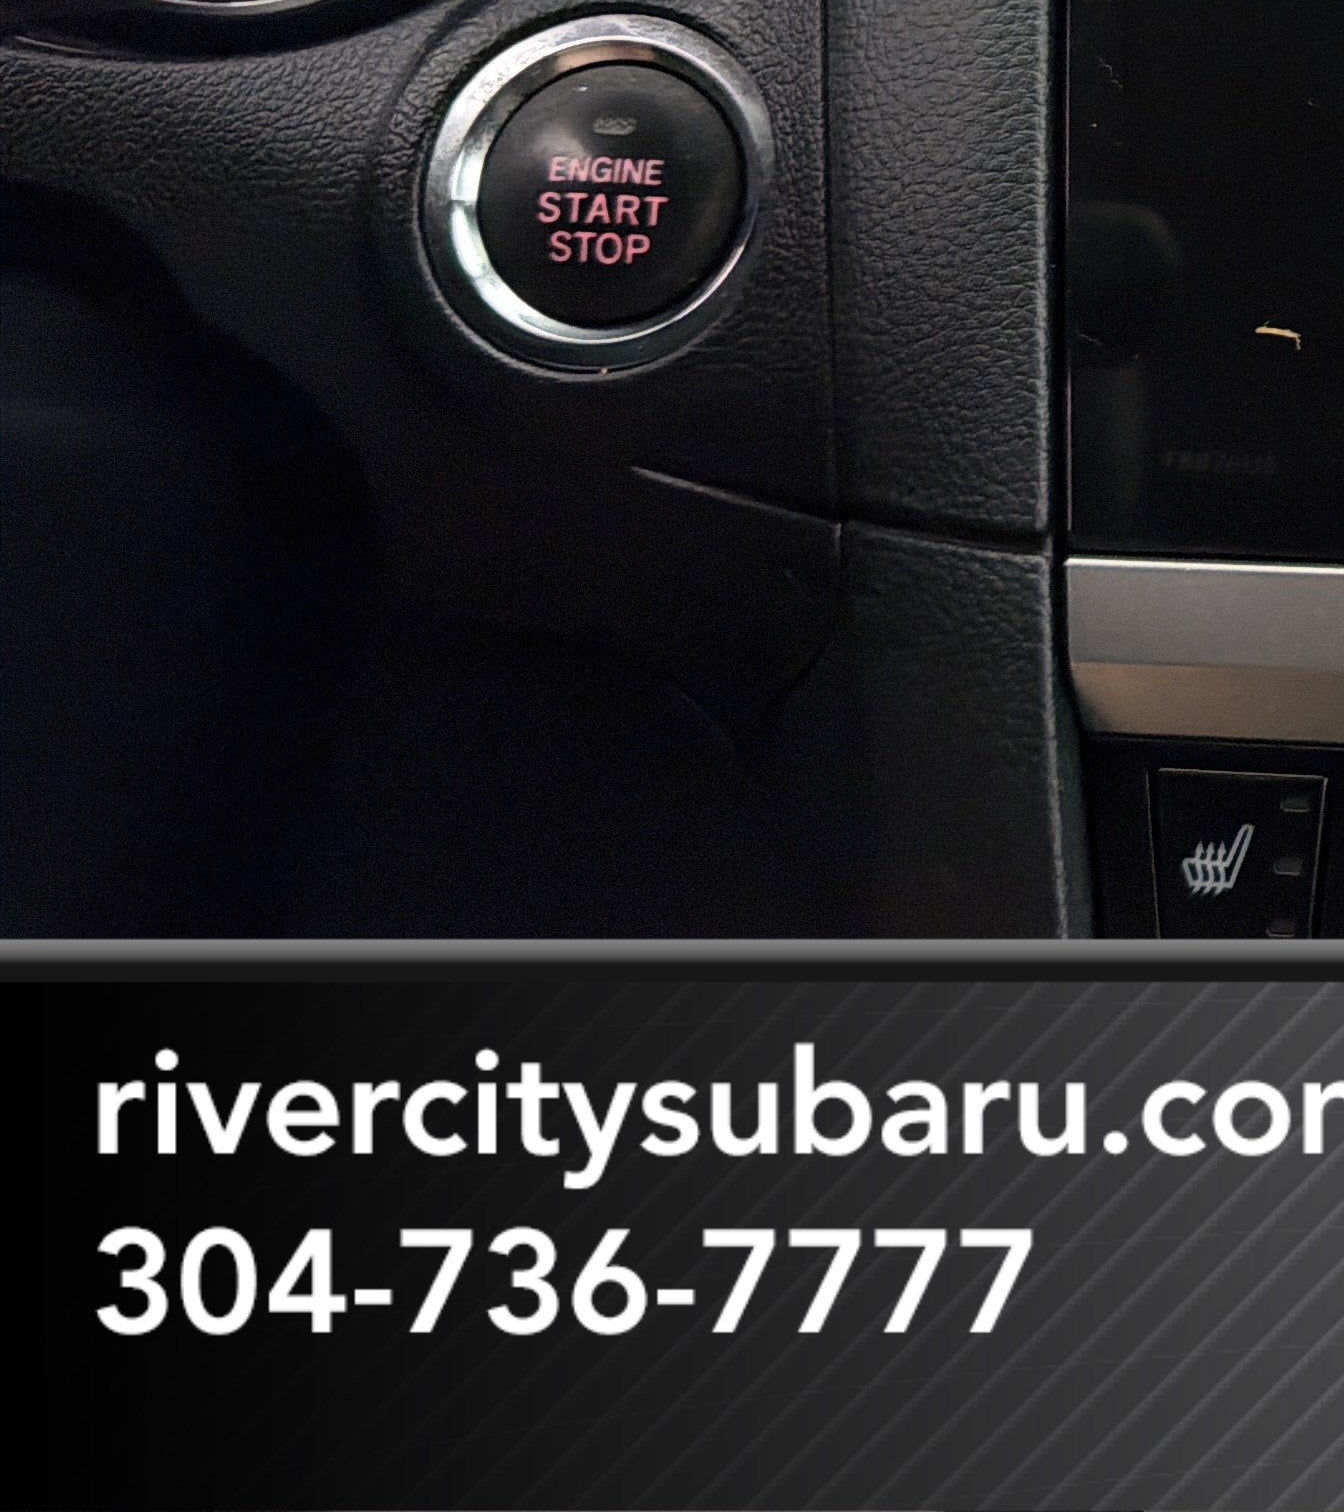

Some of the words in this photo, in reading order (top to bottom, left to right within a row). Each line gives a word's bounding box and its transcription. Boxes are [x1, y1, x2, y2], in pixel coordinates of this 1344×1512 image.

[547, 156, 665, 186] ENGINE
[538, 192, 669, 227] START
[549, 231, 651, 266] STOP
